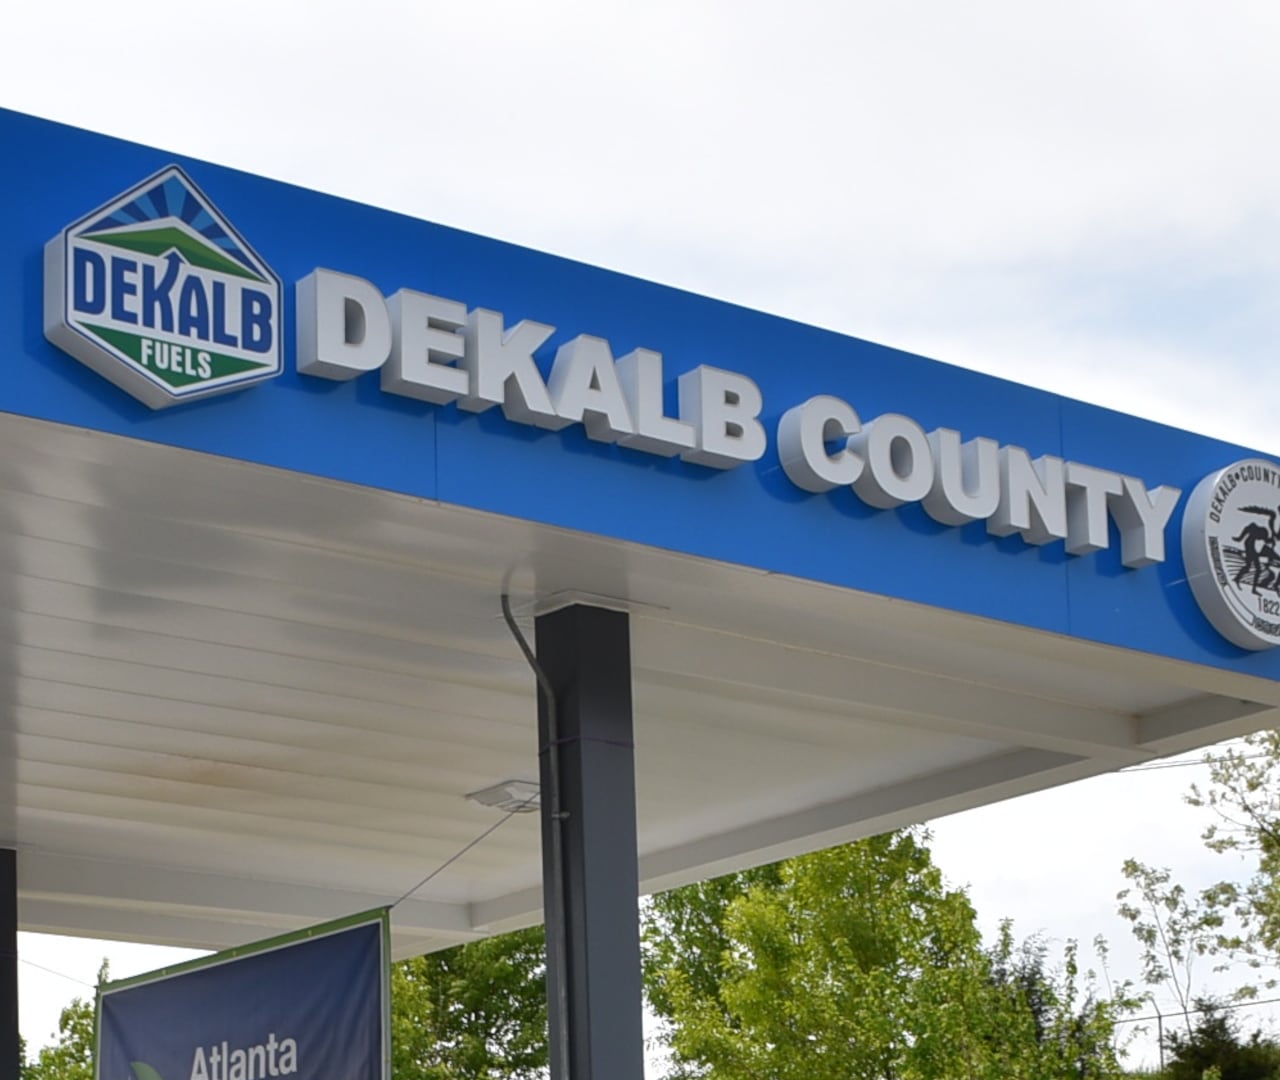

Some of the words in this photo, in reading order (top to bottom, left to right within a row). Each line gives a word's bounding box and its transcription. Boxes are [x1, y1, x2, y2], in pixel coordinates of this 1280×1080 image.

[74, 247, 272, 354] DEKALB
[141, 339, 211, 378] FUELS
[300, 268, 767, 466] DEKALB
[780, 396, 1181, 564] COUNTY
[1209, 474, 1238, 523] DEKALB
